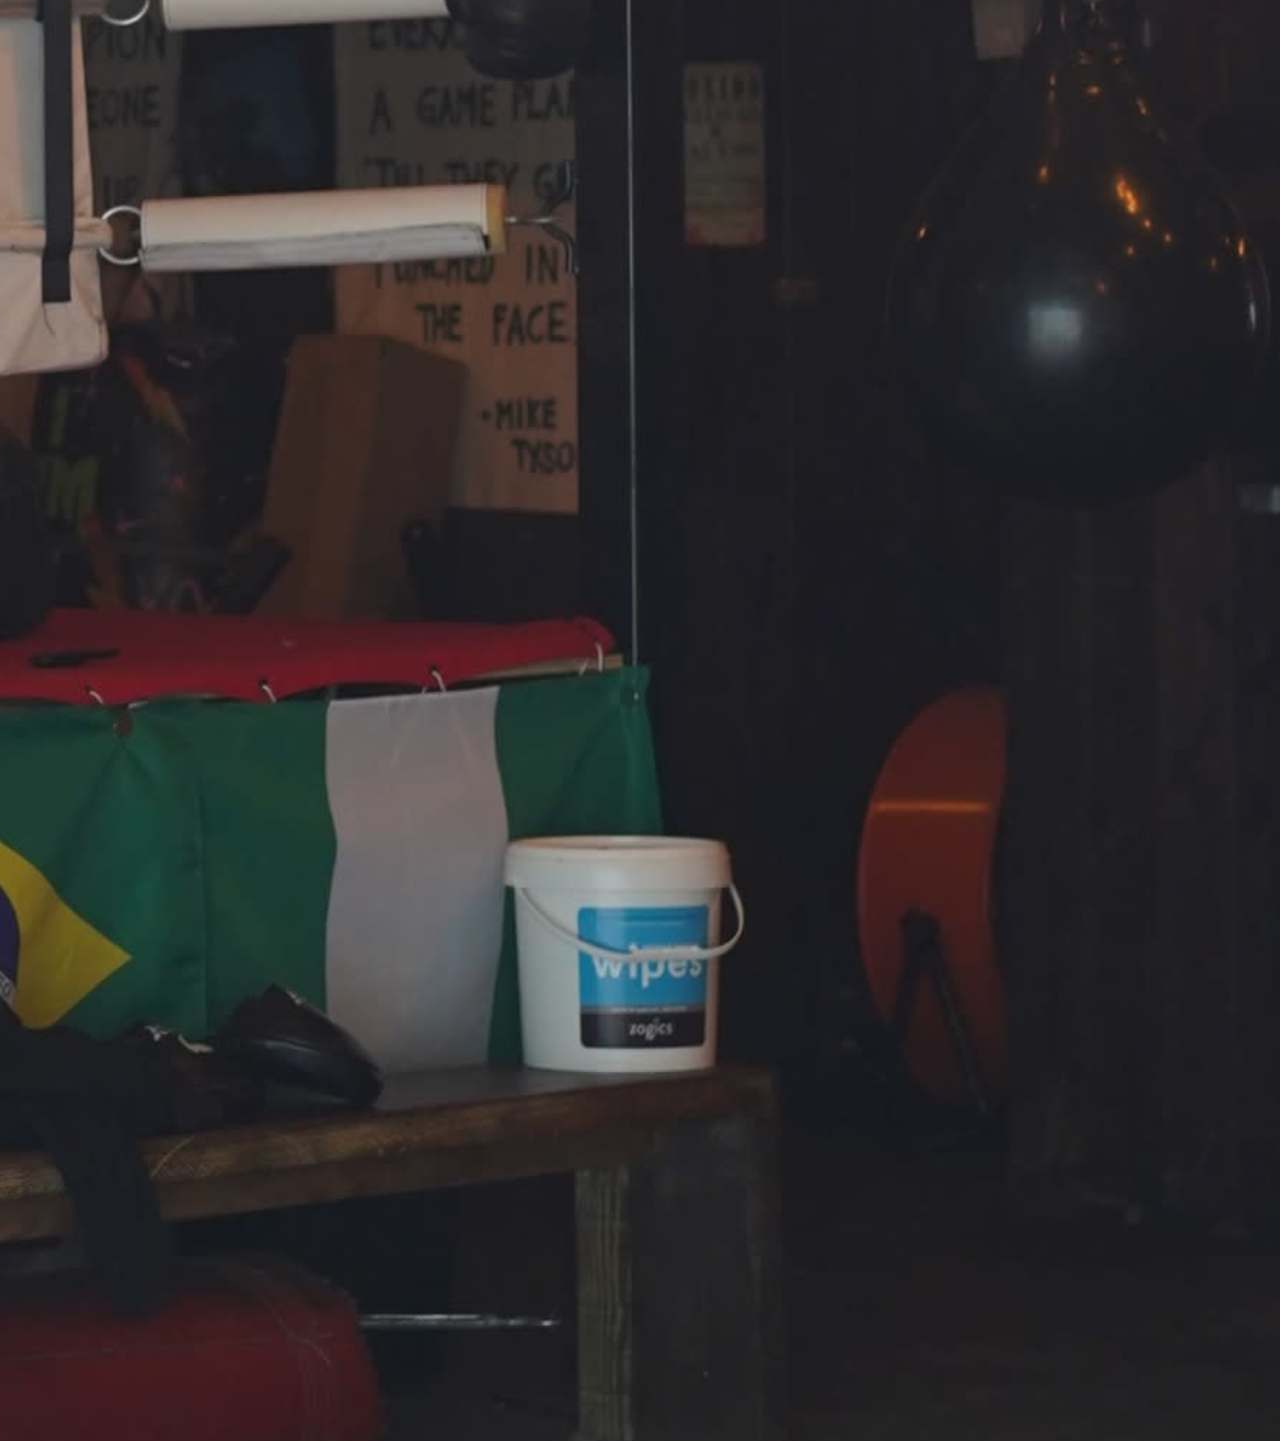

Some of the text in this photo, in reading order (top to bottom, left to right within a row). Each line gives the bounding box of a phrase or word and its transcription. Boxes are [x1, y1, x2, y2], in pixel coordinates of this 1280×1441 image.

[369, 87, 394, 135] A
[416, 82, 495, 127] GAME
[525, 242, 559, 284] IN
[415, 300, 569, 346] THE FACE
[591, 943, 702, 988] wipes
